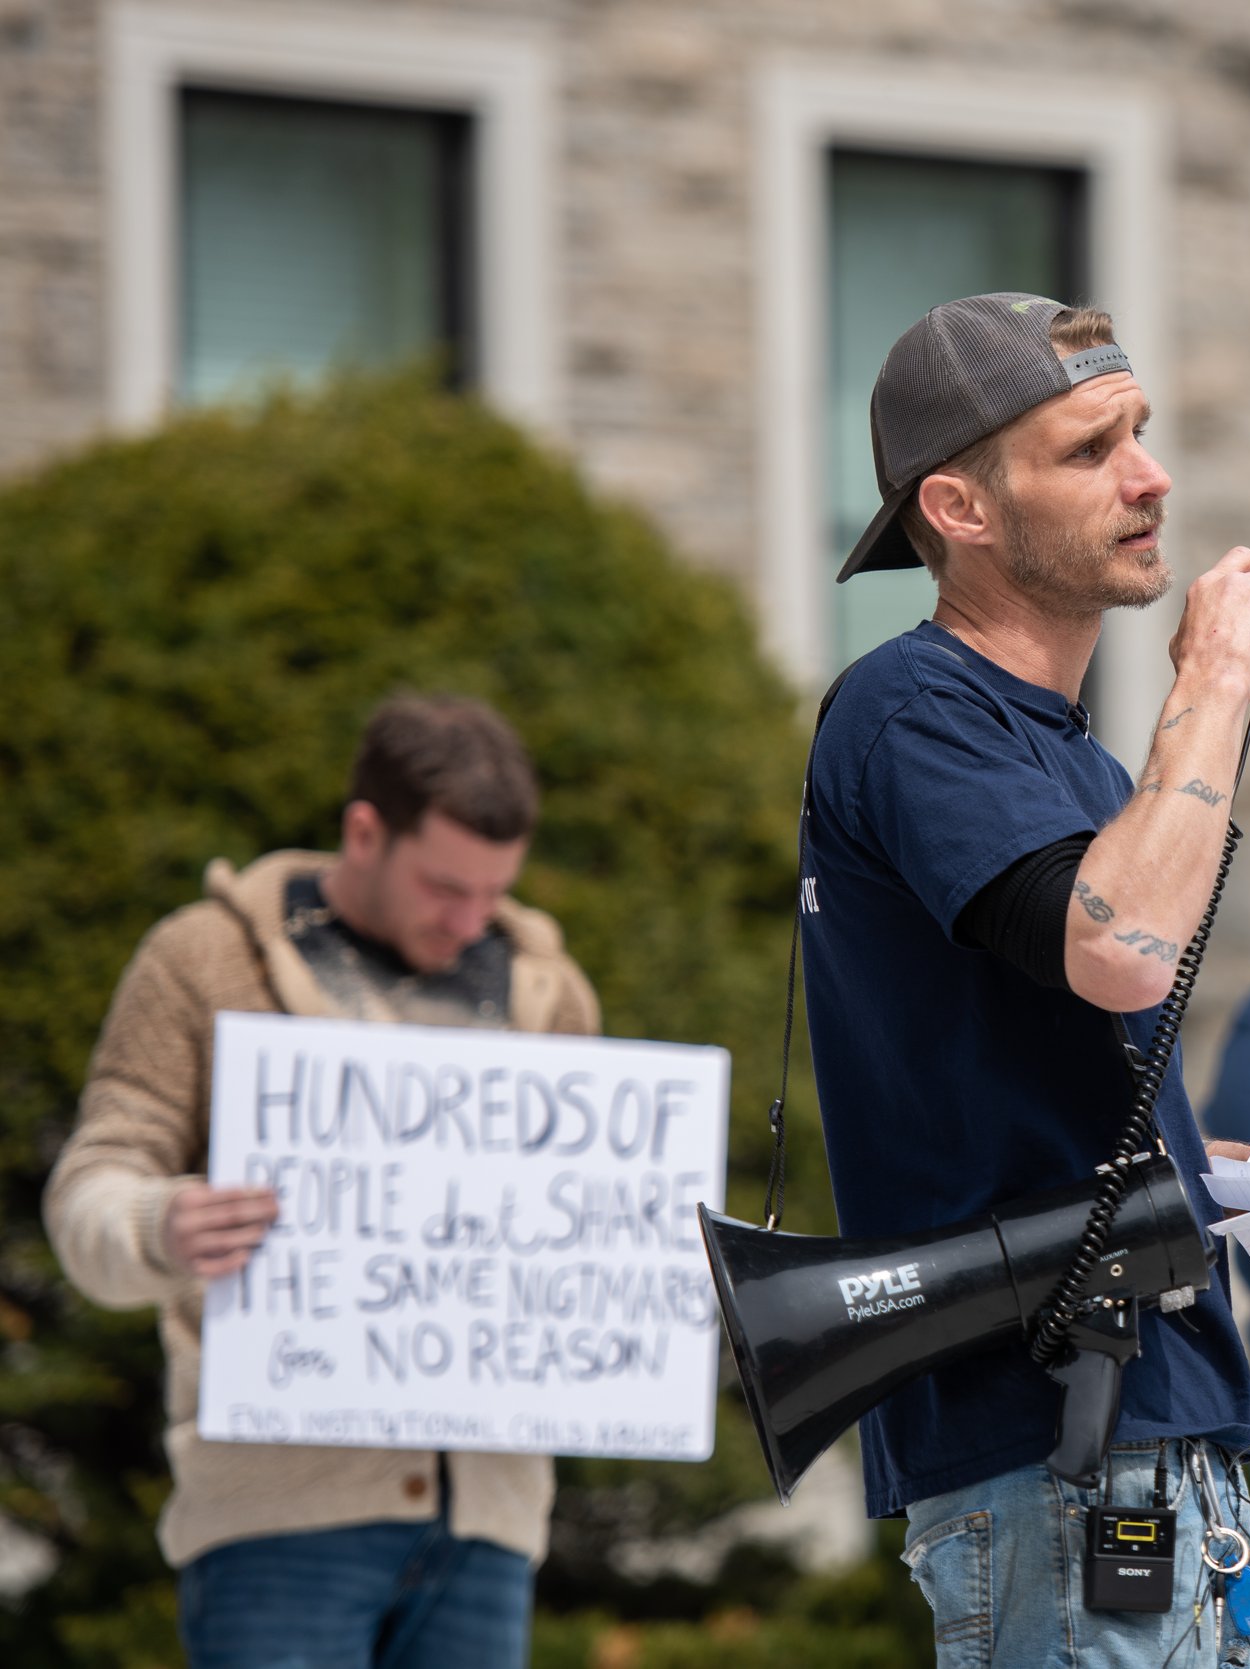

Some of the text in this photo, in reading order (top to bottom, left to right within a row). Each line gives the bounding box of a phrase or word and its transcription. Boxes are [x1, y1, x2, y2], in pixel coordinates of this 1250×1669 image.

[254, 1048, 699, 1163] HUNDREDS OF
[245, 1153, 408, 1242] PEOPLE
[546, 1170, 709, 1253] SHARE
[356, 1254, 499, 1313] SAME
[847, 1293, 926, 1322] PyleUSA.com
[364, 1320, 454, 1384] NO
[468, 1319, 670, 1387] REASON
[1116, 1567, 1152, 1577] SONY
